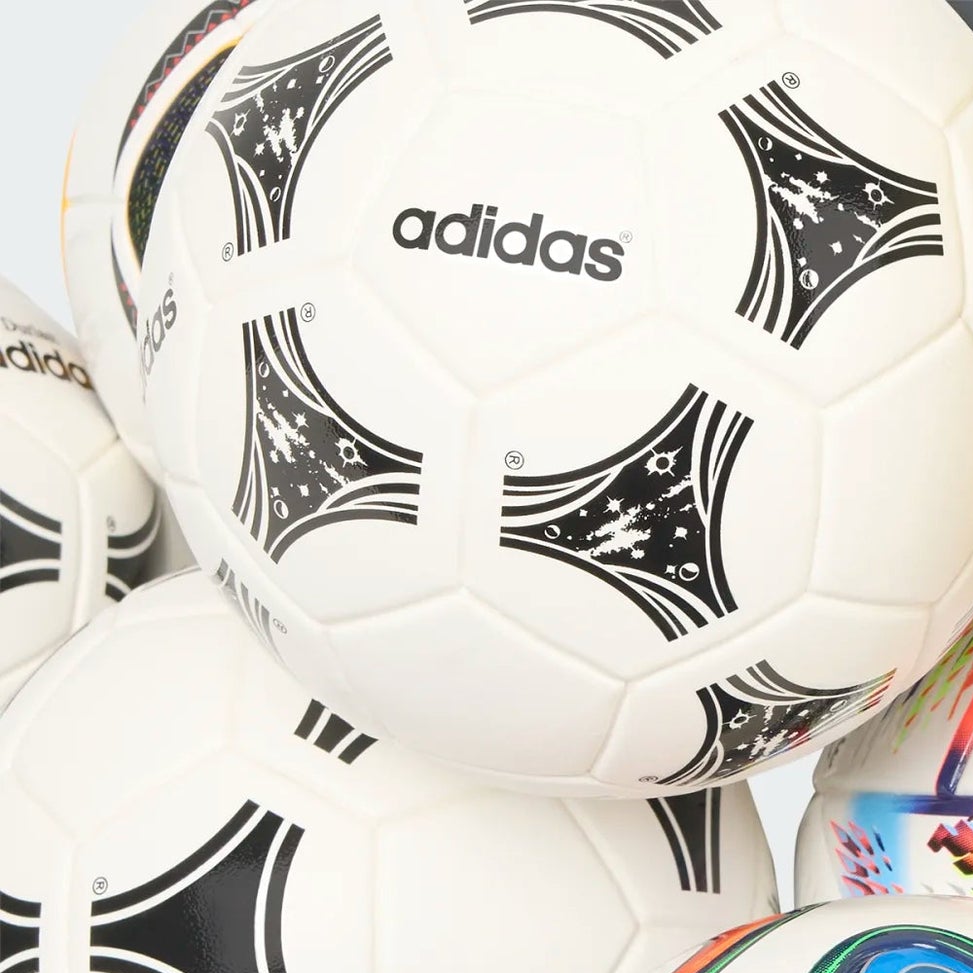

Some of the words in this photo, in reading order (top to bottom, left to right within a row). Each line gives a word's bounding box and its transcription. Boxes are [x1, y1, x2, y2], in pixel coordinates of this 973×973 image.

[393, 203, 625, 282] adidas
[0, 339, 94, 390] dida
[142, 288, 177, 375] das
